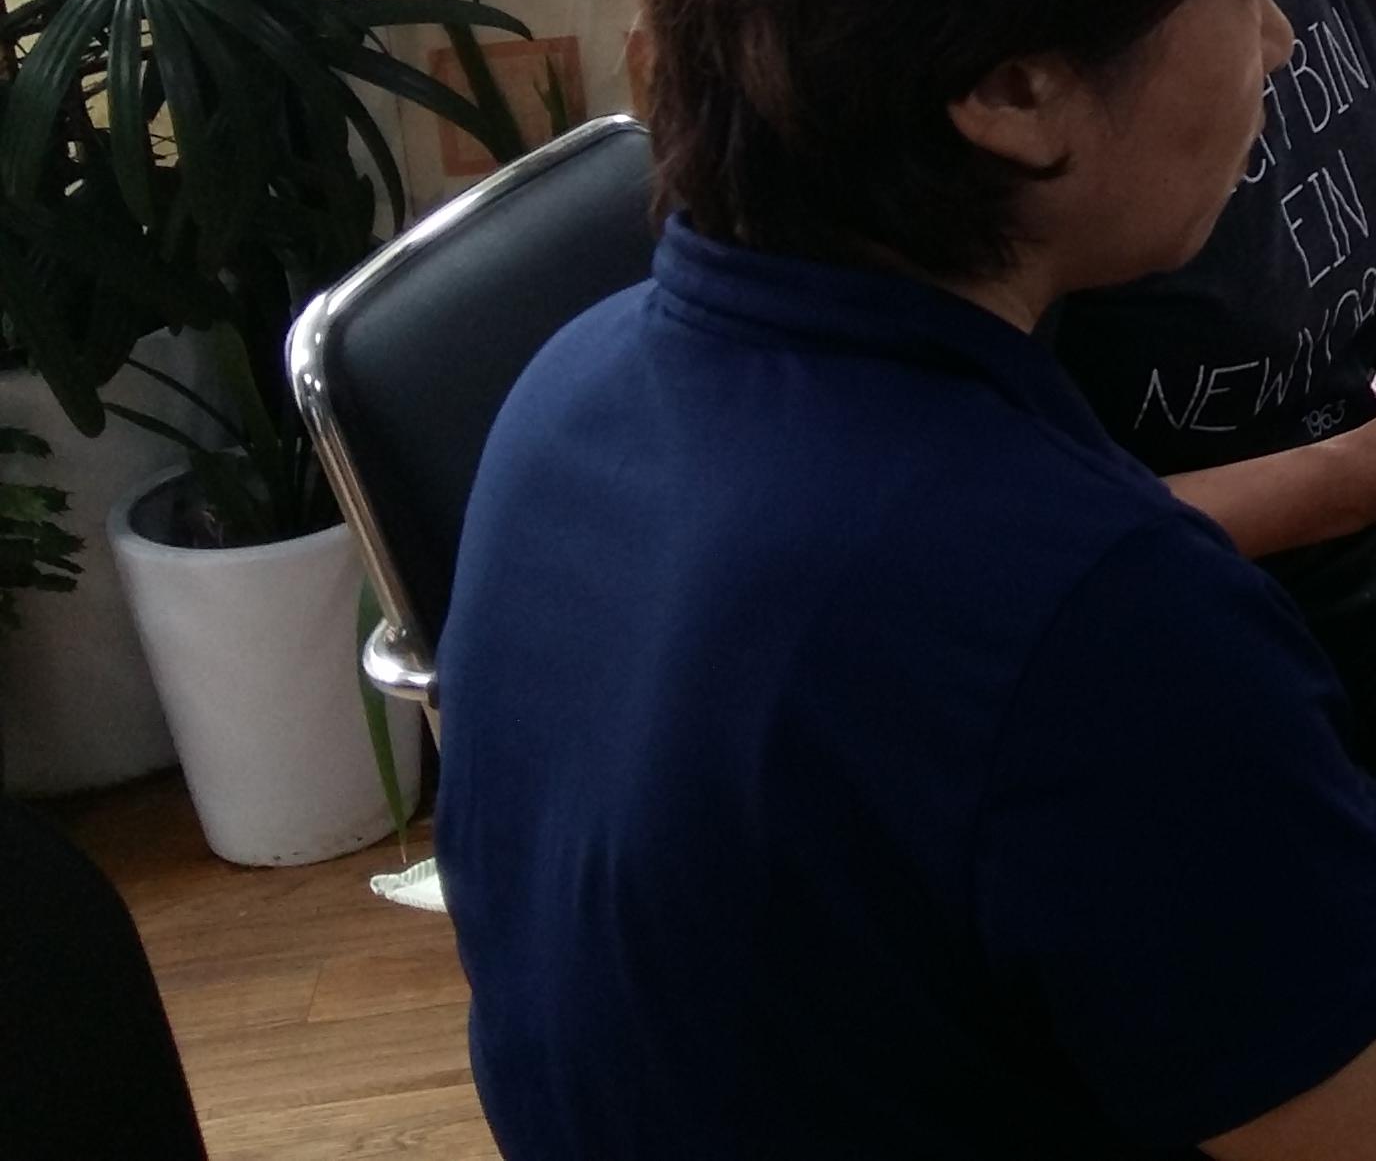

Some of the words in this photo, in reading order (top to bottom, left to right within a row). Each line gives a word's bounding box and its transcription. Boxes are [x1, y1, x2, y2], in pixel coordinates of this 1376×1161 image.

[1287, 7, 1369, 133] BIN
[1281, 149, 1369, 288] EIN
[1133, 331, 1303, 433] NEW
